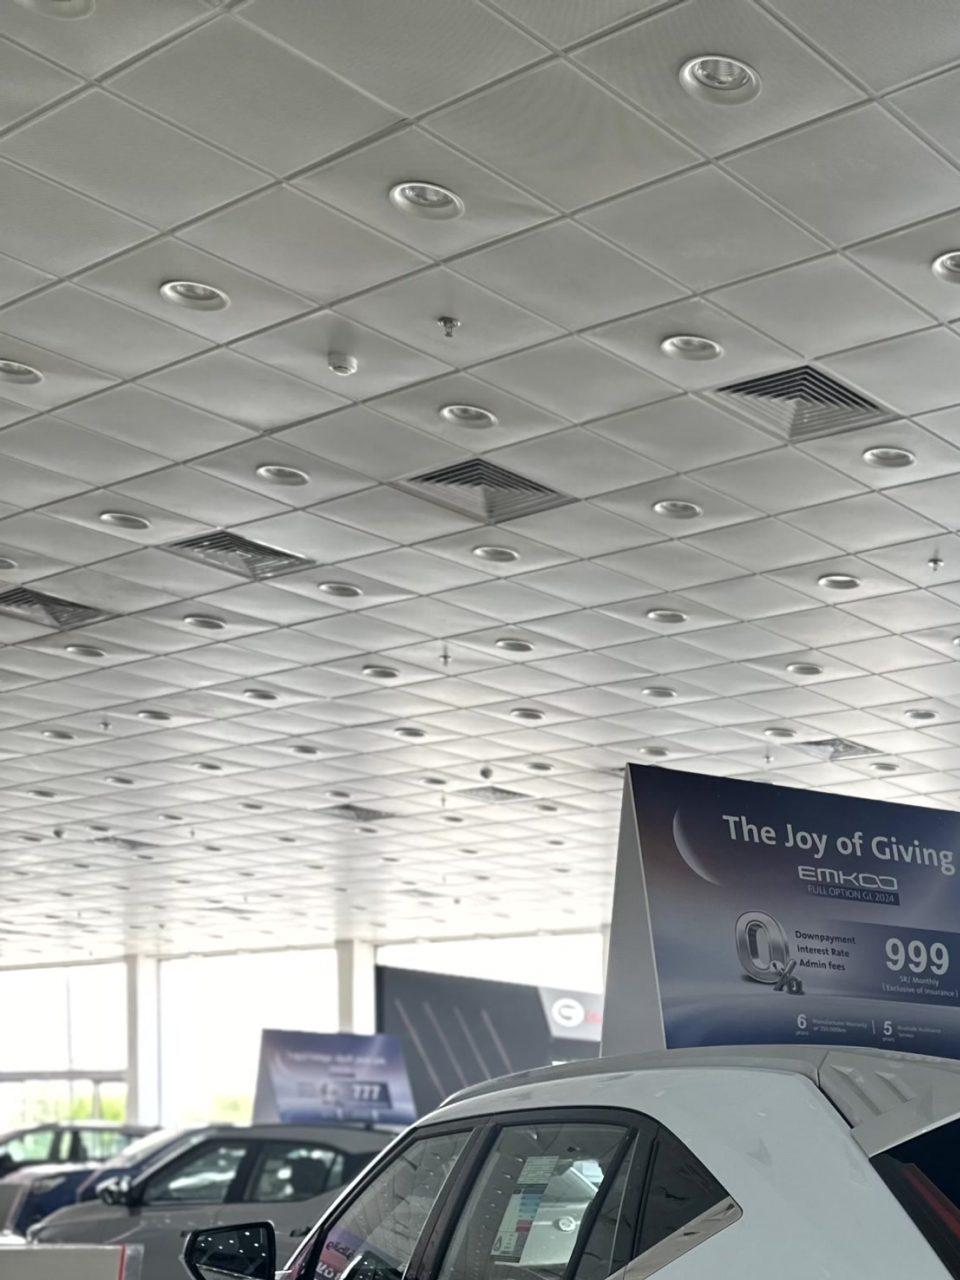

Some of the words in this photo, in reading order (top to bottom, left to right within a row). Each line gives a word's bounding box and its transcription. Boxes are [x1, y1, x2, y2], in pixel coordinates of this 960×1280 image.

[722, 815, 777, 845] The
[785, 823, 828, 859] Joy
[836, 831, 863, 857] of
[871, 836, 956, 876] Giving
[828, 886, 861, 900] OPTION
[794, 930, 857, 947] Downpayment
[797, 944, 830, 957] Interest
[831, 949, 851, 959] Rate
[884, 937, 950, 976] 999
[799, 958, 828, 970] Admin
[828, 961, 846, 972] fees
[796, 1013, 808, 1029] 6
[883, 1020, 893, 1036] 5
